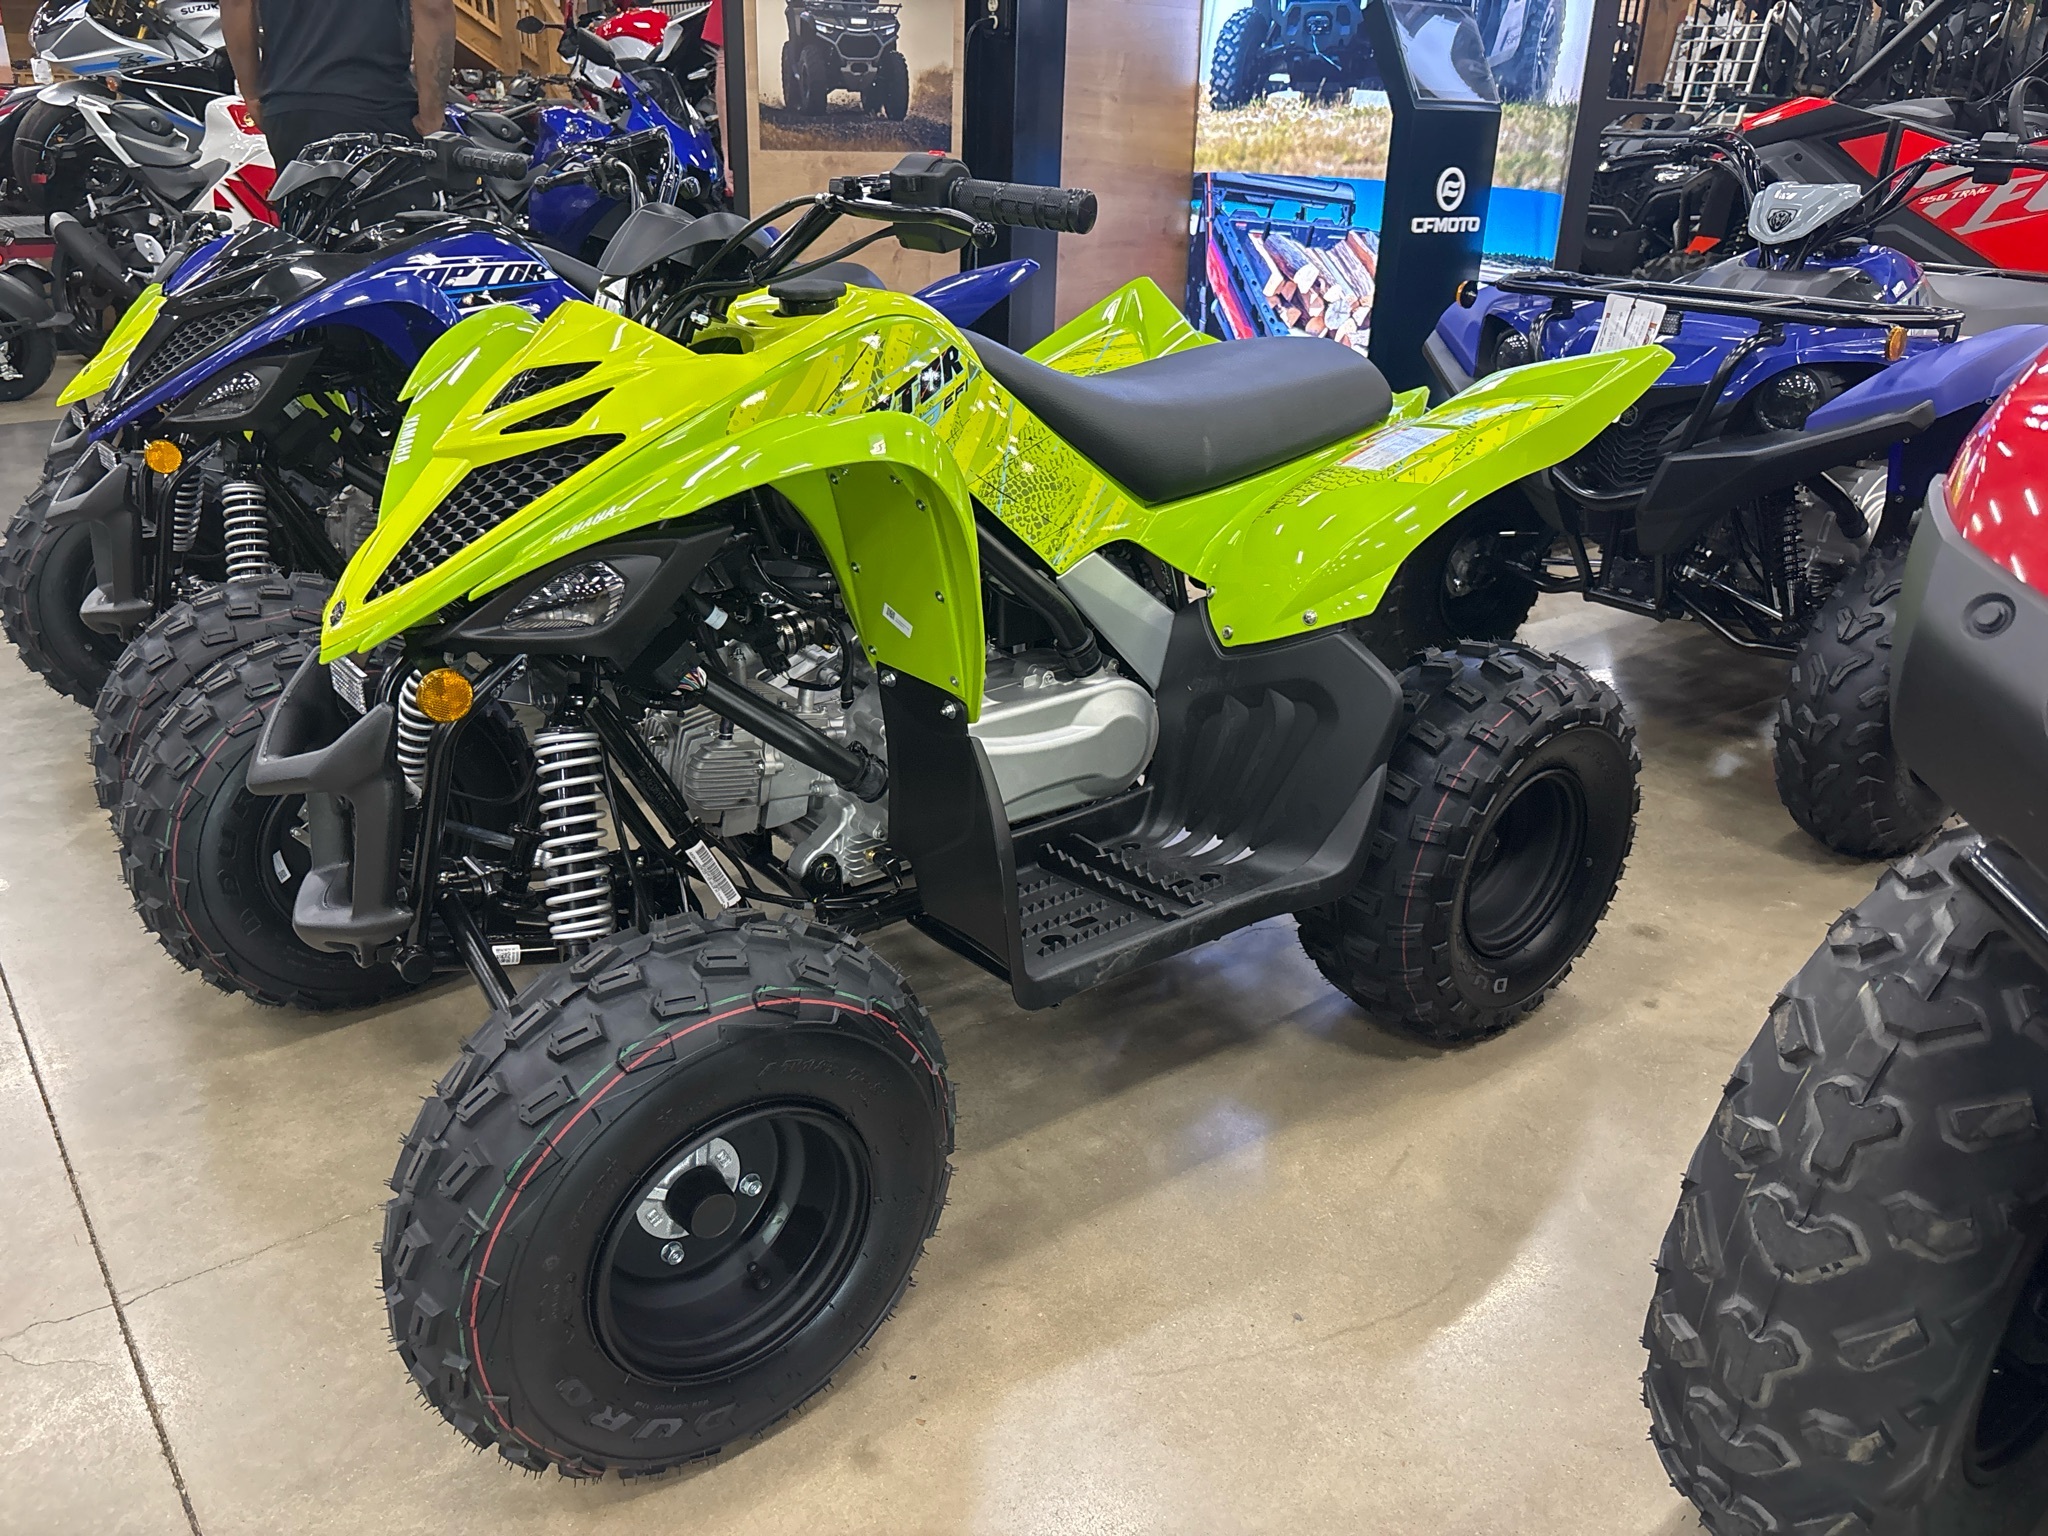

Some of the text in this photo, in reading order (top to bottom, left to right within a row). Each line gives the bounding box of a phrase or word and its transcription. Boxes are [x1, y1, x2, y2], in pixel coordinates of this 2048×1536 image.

[180, 3, 219, 15] SUZUK
[1919, 186, 1992, 205] 950 TRAIL
[1410, 216, 1480, 234] CFMOTO
[393, 413, 422, 466] YAMAHA
[549, 504, 617, 546] YAMAHA
[555, 1377, 741, 1441] DURO
